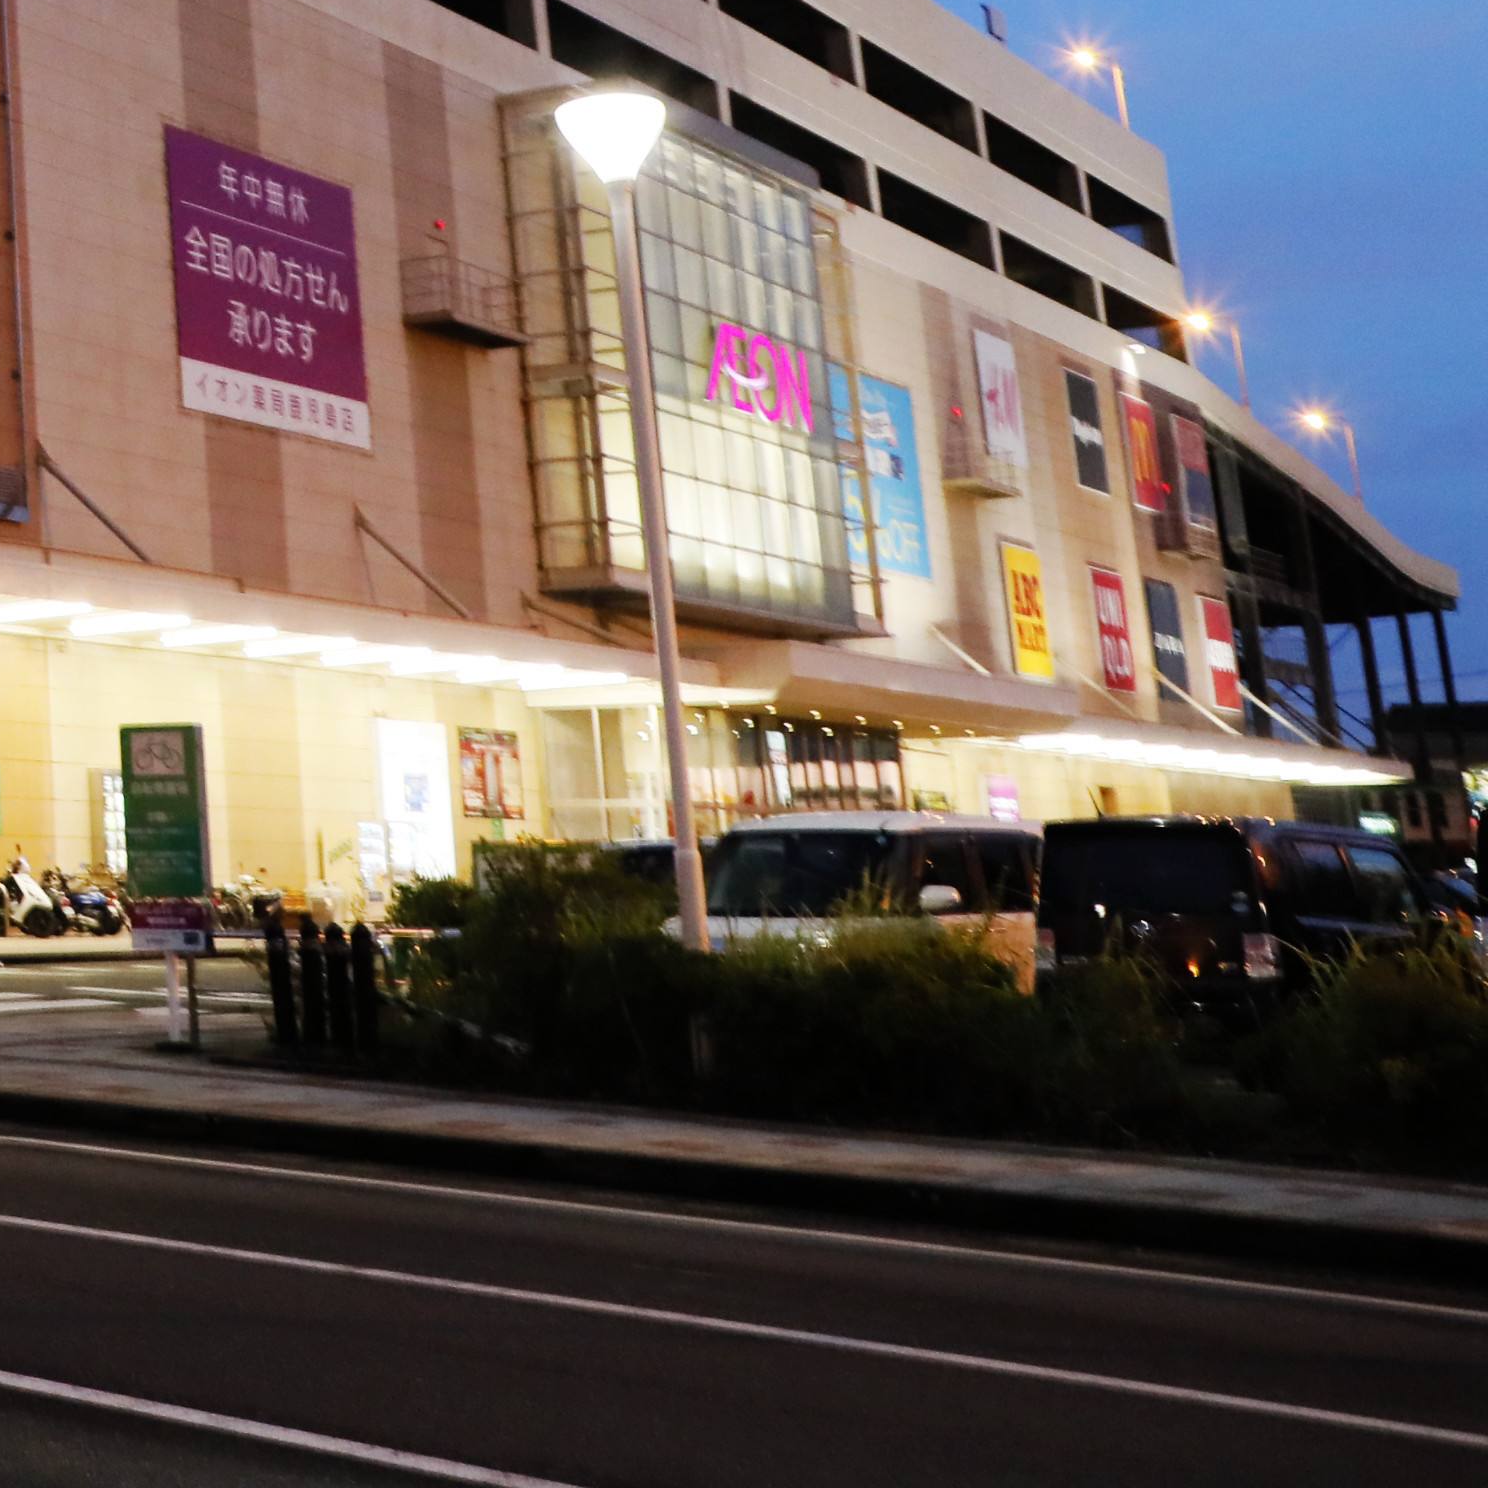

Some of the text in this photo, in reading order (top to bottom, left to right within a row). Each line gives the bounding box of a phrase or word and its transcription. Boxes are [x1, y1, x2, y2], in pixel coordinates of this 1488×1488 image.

[218, 160, 310, 225] 年中無休
[184, 224, 349, 315] 全国の処方せん
[227, 299, 317, 363] 承ります
